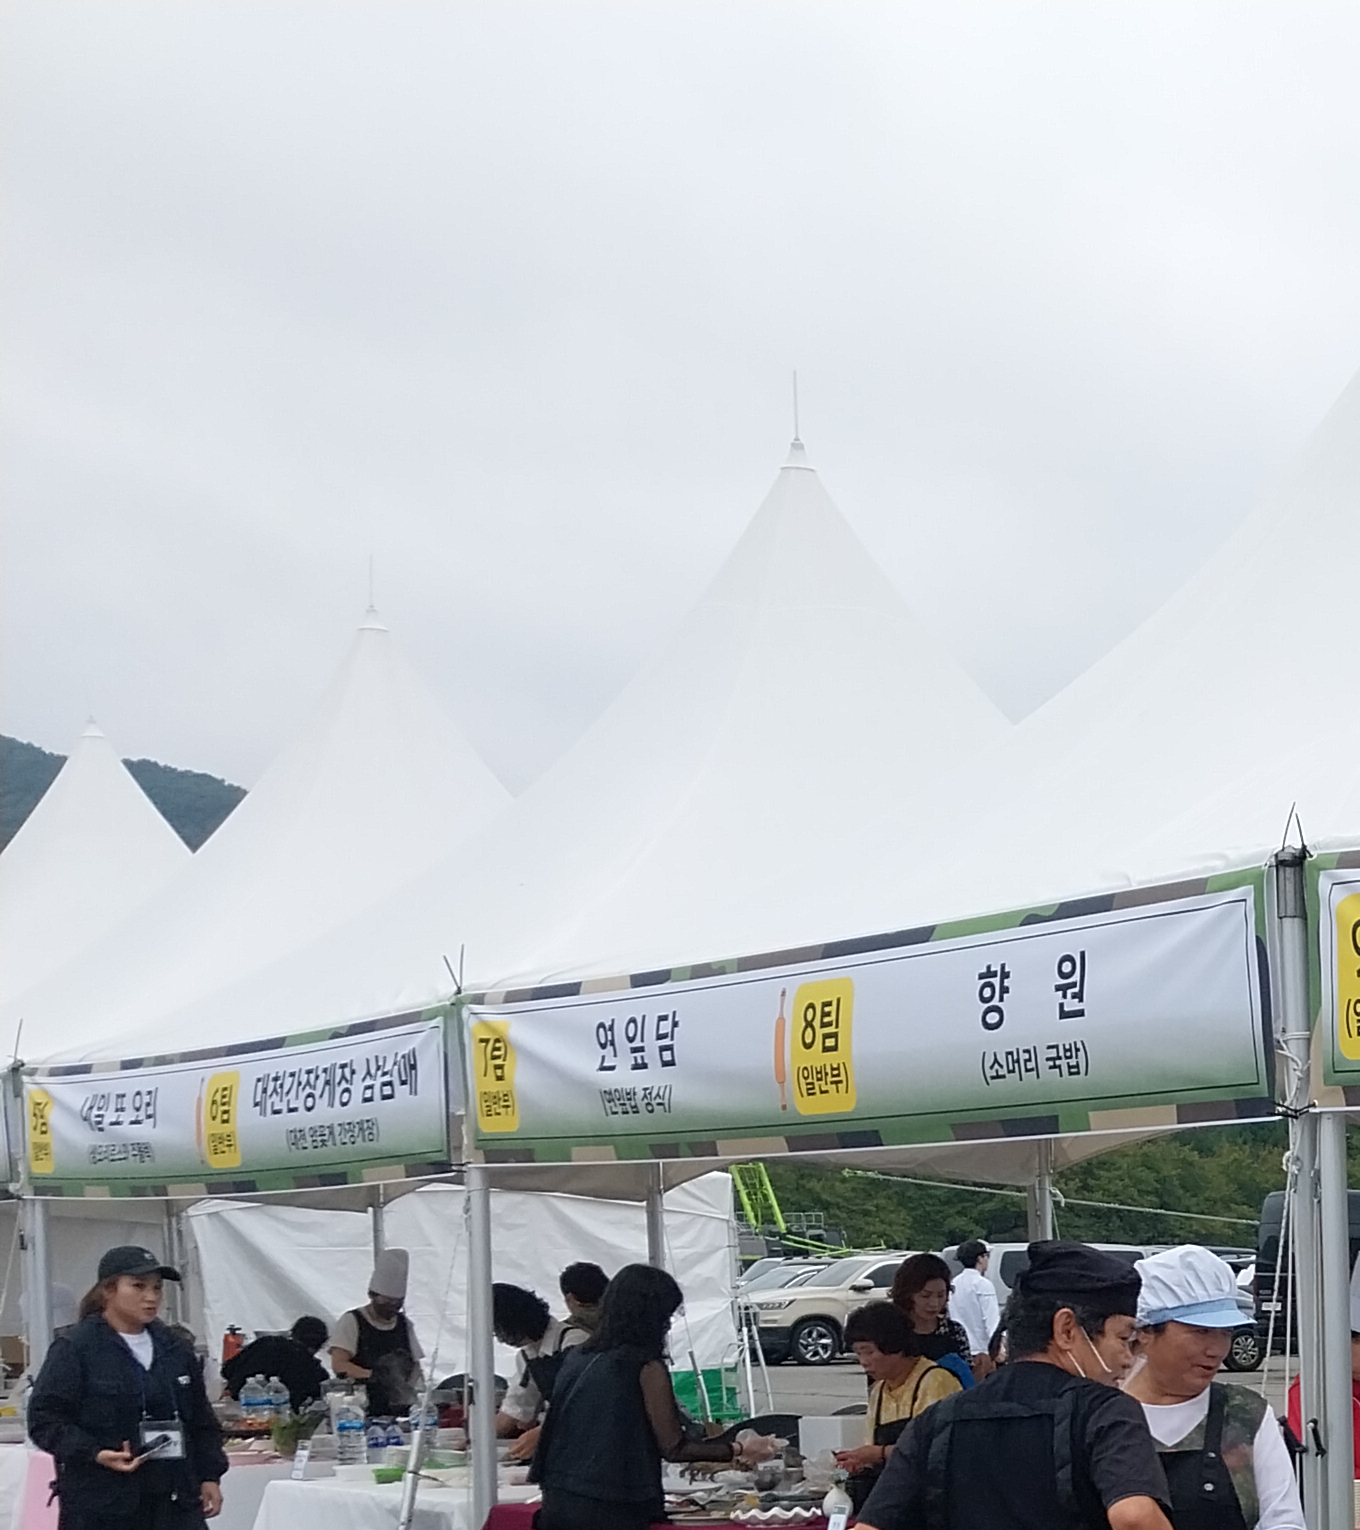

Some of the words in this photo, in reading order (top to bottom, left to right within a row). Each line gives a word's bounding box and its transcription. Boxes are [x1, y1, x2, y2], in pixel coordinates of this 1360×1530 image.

[801, 997, 841, 1053] 8팀
[478, 1037, 508, 1081] 7팀
[796, 1062, 849, 1097] (일반부)
[981, 1045, 1040, 1086] (소머리
[1045, 1040, 1089, 1077] 국밥)
[253, 1059, 356, 1116] 대천간장게장
[361, 1047, 418, 1104] 삼남매
[480, 1090, 515, 1117] (일반부)
[209, 1084, 232, 1124] 6팀
